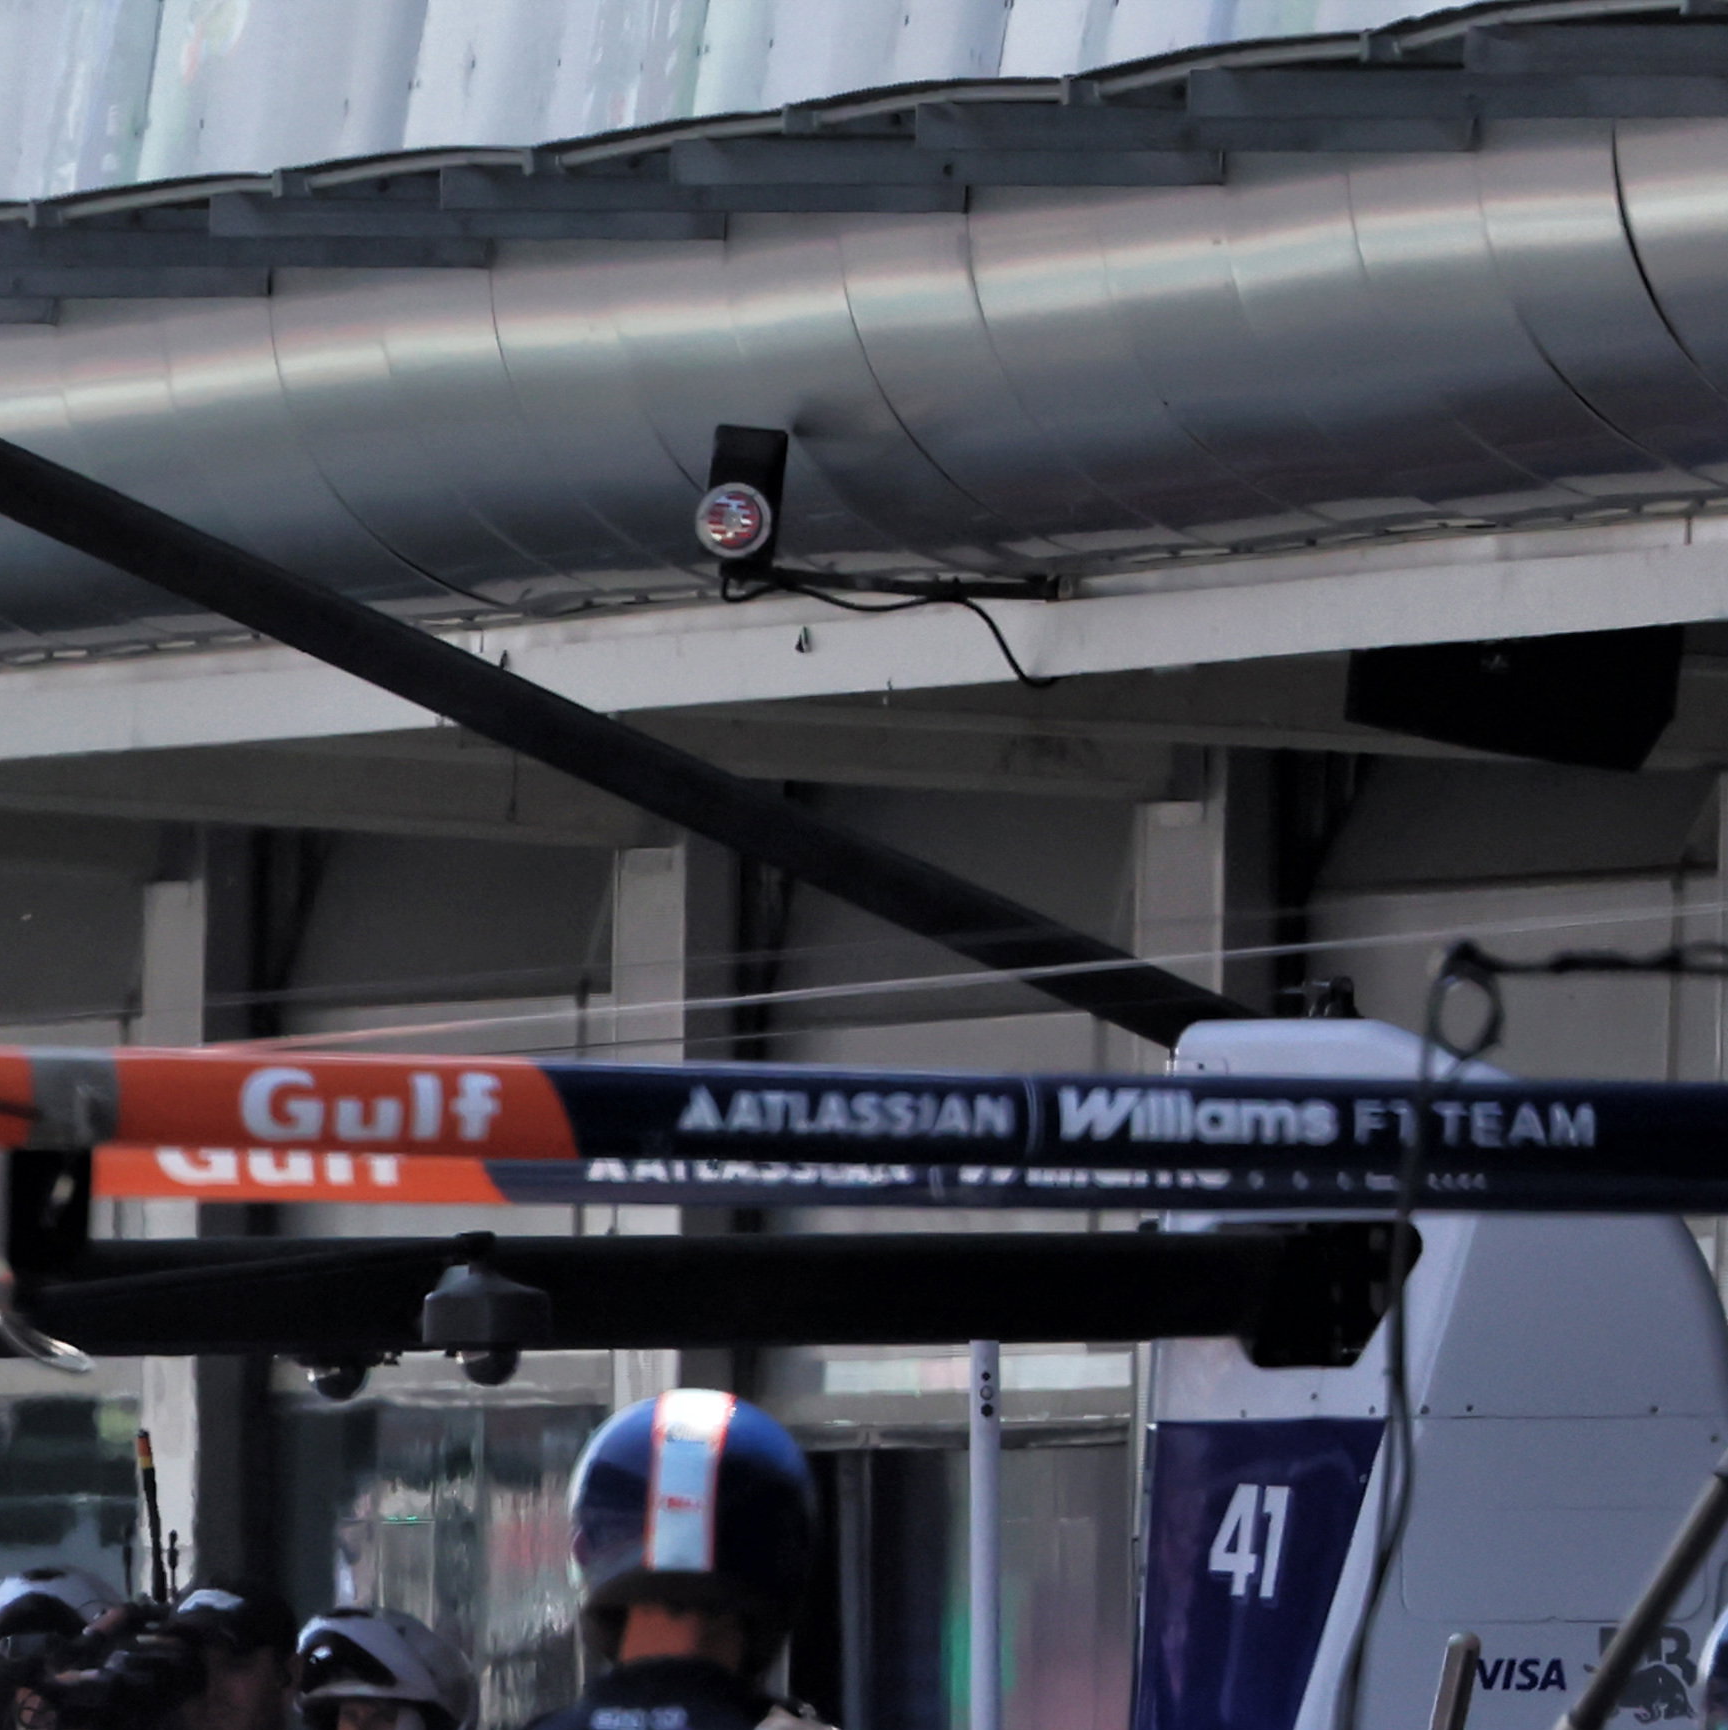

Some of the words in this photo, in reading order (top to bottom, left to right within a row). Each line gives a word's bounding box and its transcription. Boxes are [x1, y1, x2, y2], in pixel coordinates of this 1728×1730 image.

[239, 1066, 501, 1142] Gulf
[723, 1089, 1015, 1138] ATLASSIAN
[1057, 1086, 1339, 1145] Williams
[1431, 1101, 1596, 1148] TEAM
[1208, 1483, 1291, 1598] 41
[1477, 1658, 1567, 1691] VISA
